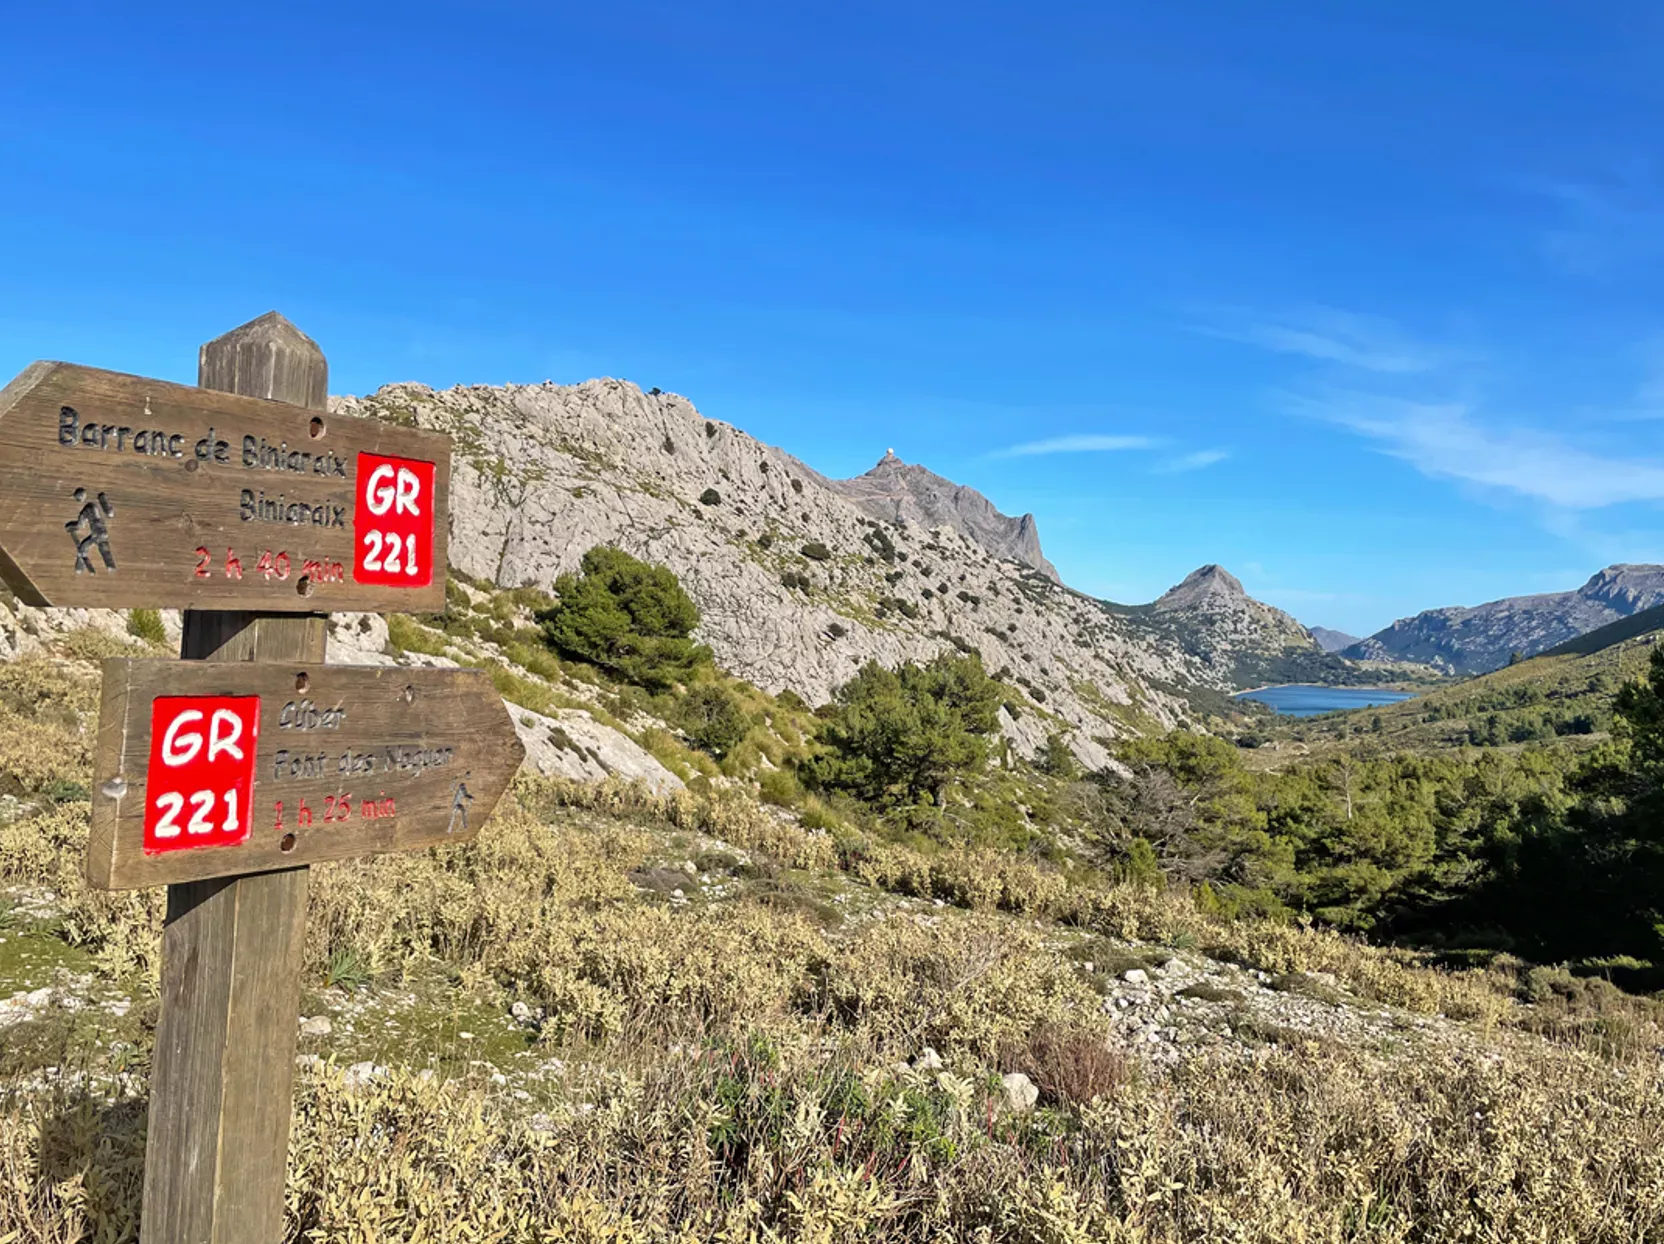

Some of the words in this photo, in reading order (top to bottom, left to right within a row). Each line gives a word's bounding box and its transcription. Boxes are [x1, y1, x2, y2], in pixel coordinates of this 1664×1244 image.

[59, 406, 185, 458] Barranc
[195, 427, 230, 463] de
[242, 434, 348, 479] Biniaraix
[240, 488, 345, 529] Biniaraix
[366, 464, 420, 516] GR
[194, 546, 211, 578] 2
[225, 546, 243, 580] h
[256, 548, 291, 580] 40
[301, 555, 345, 583] min
[363, 529, 418, 576] 221
[161, 708, 244, 767] GR
[273, 750, 327, 781] Font
[337, 746, 375, 776] des
[154, 788, 240, 838] 221
[274, 800, 284, 830] 1
[298, 798, 313, 827] h
[323, 792, 351, 823] 25
[361, 790, 396, 820] min
